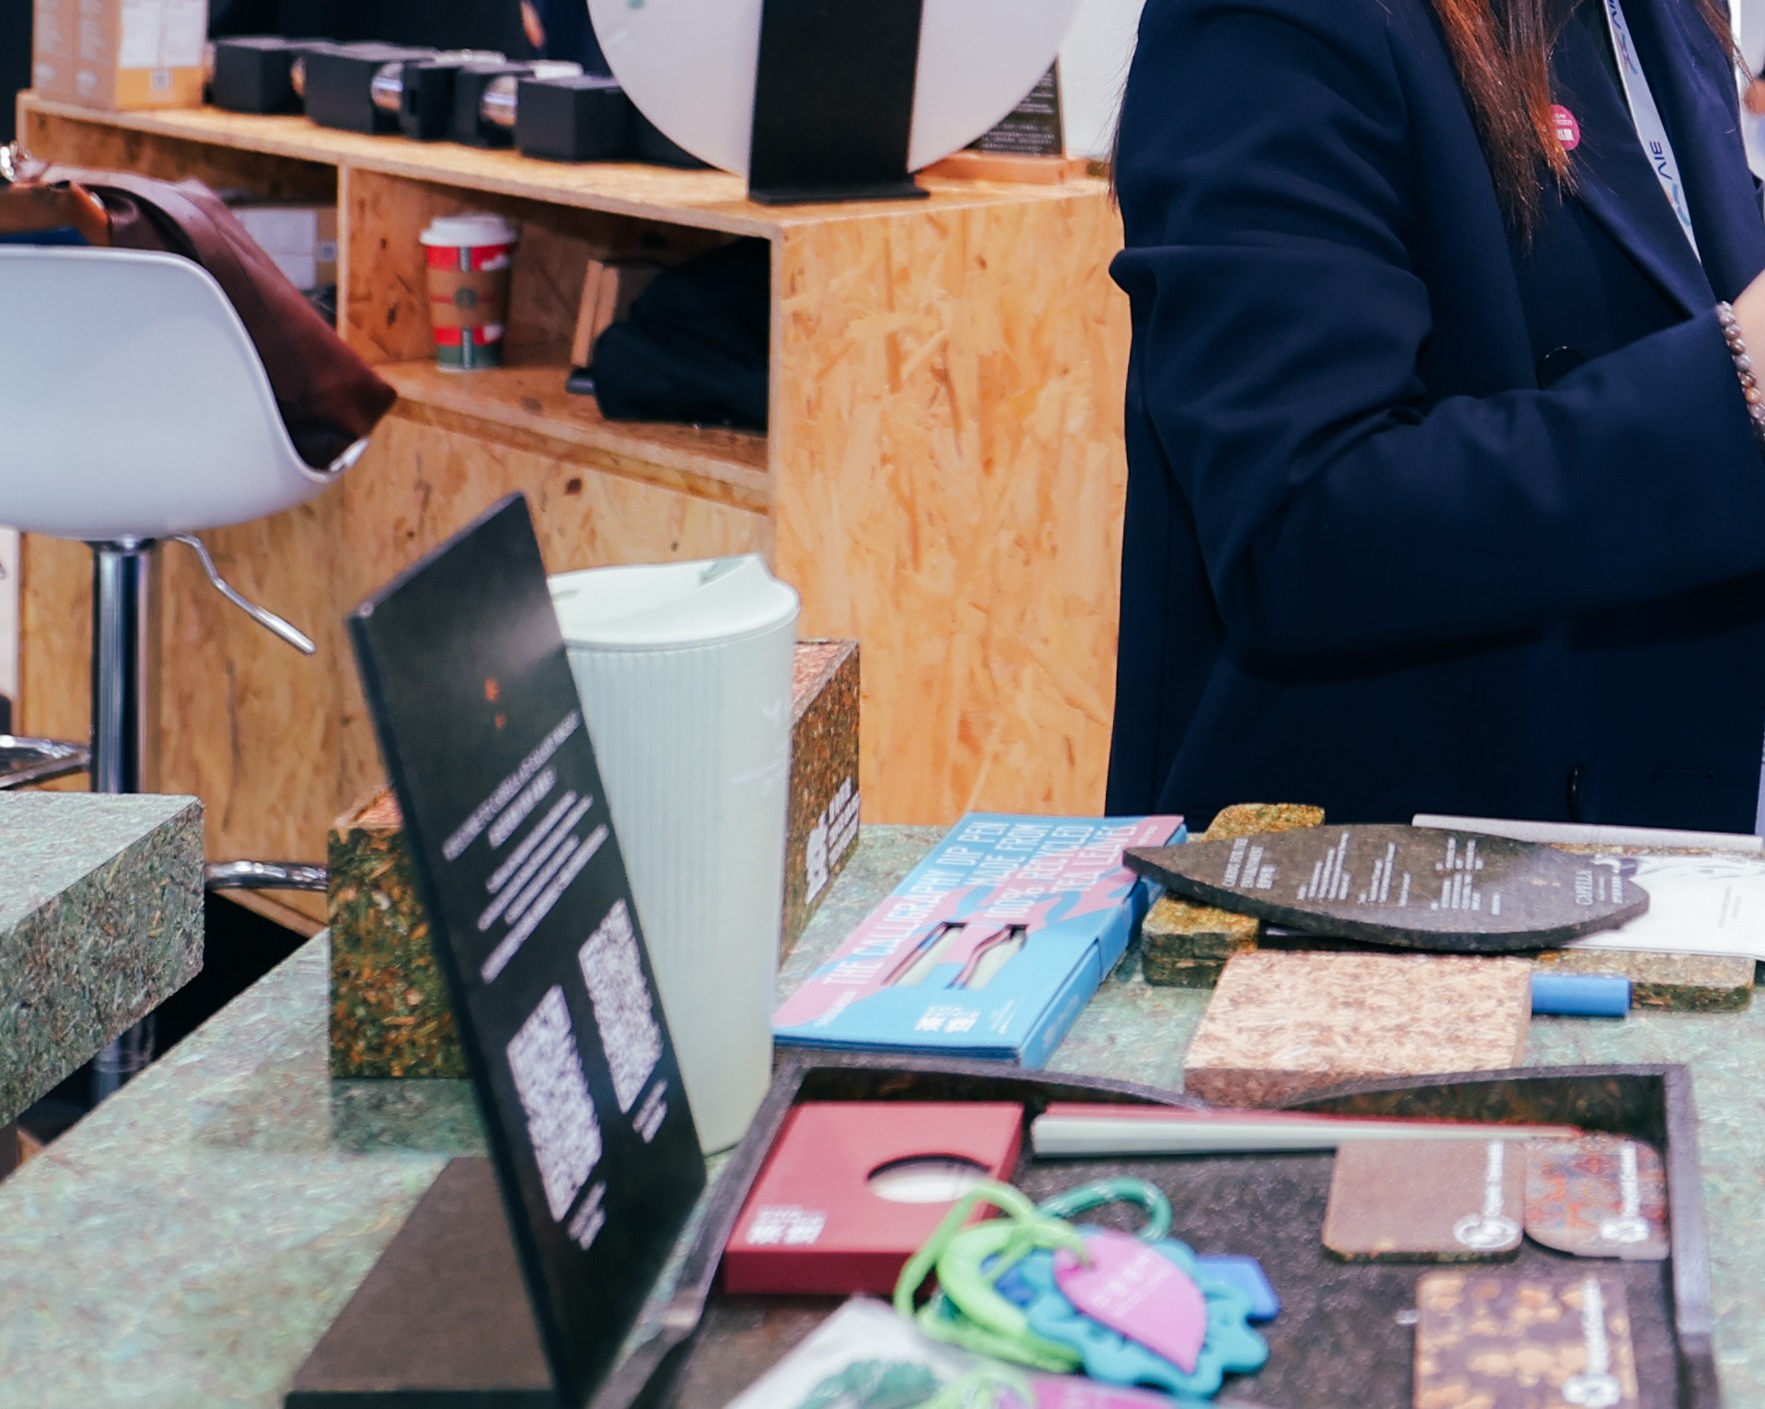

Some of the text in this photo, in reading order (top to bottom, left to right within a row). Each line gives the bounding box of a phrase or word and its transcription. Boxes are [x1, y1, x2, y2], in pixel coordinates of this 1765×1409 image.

[935, 846, 984, 867] DIP
[957, 821, 1011, 843] PEN
[965, 823, 1053, 888] MADE FROM
[1051, 825, 1138, 894] TEA LEAVES
[983, 884, 1045, 920] 100%
[1016, 825, 1096, 882] RECYCLED
[852, 869, 965, 966] CALLIGRAPHY
[823, 957, 885, 986] THE
